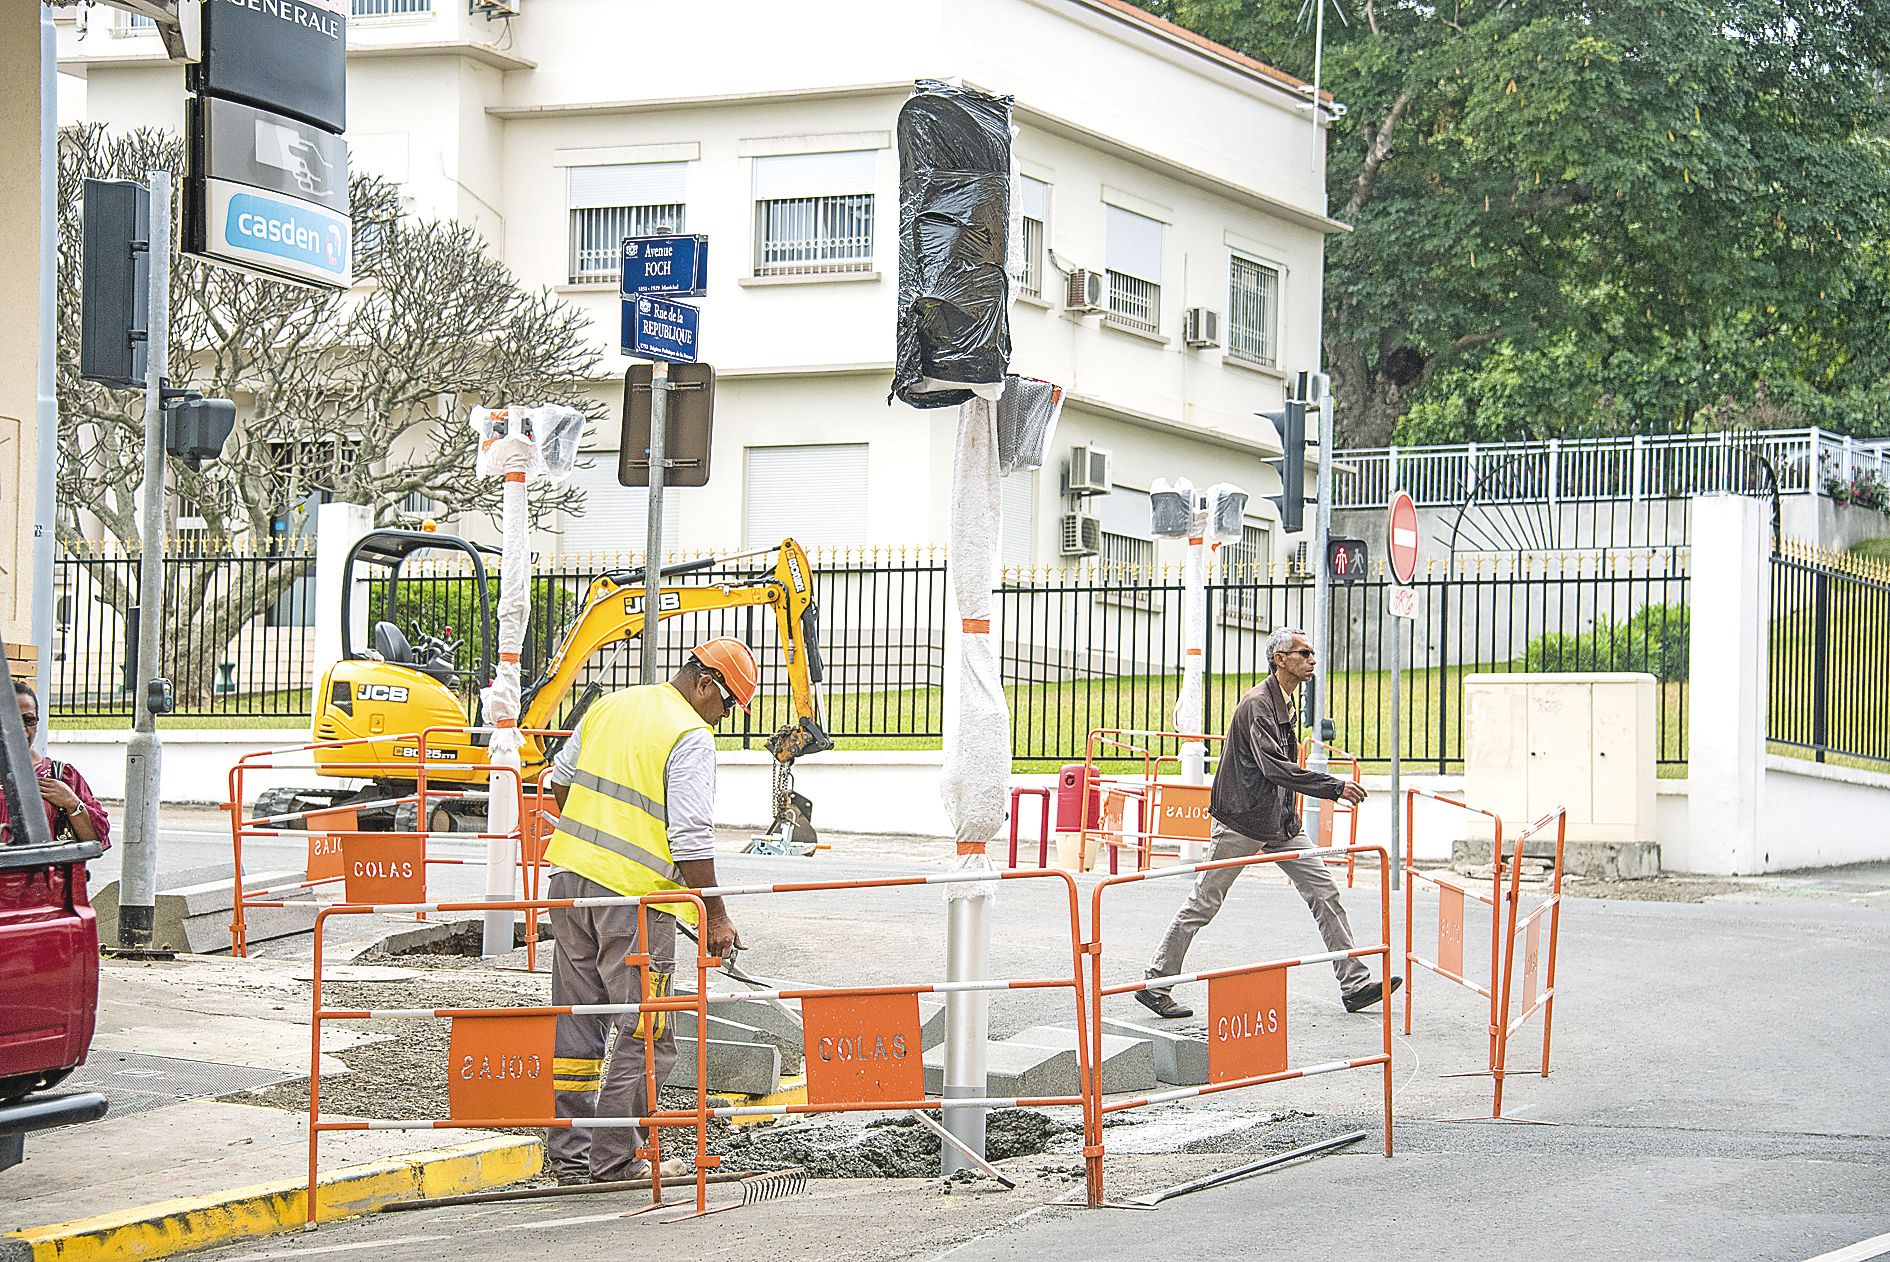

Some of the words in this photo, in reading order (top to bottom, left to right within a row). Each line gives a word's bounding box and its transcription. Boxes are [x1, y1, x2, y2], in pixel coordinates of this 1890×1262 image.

[238, 213, 320, 254] casden
[644, 243, 674, 258] Avenue
[644, 260, 672, 277] FOCH
[653, 303, 668, 320] Rue
[668, 306, 677, 322] de
[676, 308, 684, 324] la
[642, 319, 693, 346] REPUBLIQUE
[357, 684, 409, 703] JCB
[354, 861, 413, 879] COLAS
[1218, 1008, 1278, 1042] COLAS
[819, 1034, 907, 1063] COLAS
